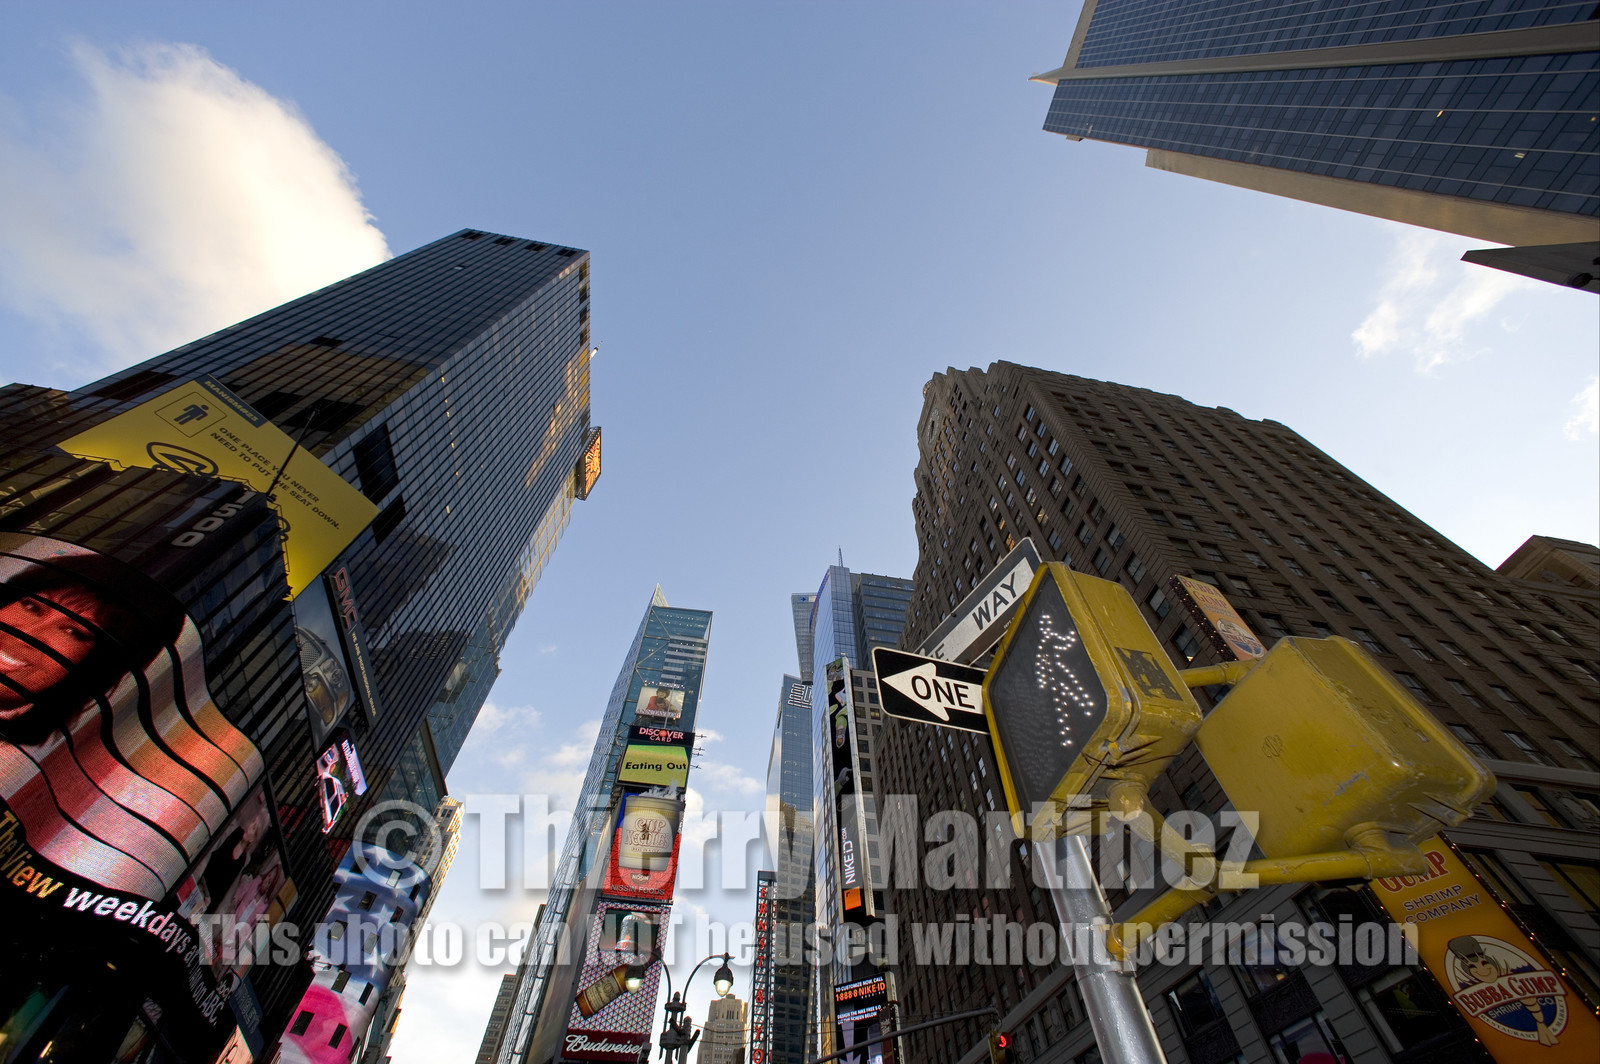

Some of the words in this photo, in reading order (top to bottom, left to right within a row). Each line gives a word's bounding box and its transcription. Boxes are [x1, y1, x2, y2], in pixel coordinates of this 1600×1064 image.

[210, 432, 238, 452] NEED
[239, 452, 251, 463] TO
[252, 463, 272, 477] PUT
[275, 478, 289, 491] HE
[289, 490, 312, 507] SEAT
[312, 507, 340, 530] DOWN.
[219, 427, 241, 443] ONE
[241, 443, 271, 466] PLACE
[291, 480, 320, 503] NEVER
[335, 567, 358, 629] GMC
[972, 572, 1019, 631] WAY
[911, 674, 976, 709] ONE
[639, 727, 684, 740] DISCOVER
[625, 762, 662, 771] Eating
[667, 762, 687, 770] Out
[625, 830, 669, 848] NOODLES
[635, 817, 666, 833] CUP
[610, 884, 636, 892] NISSIN
[638, 886, 665, 895] FOODS
[1402, 884, 1463, 911] SHRIMP
[1405, 893, 1482, 925] COMPANY
[757, 887, 768, 969] ERNST
[62, 887, 192, 953] weekdays
[192, 981, 207, 1005] on
[755, 989, 765, 1003] &
[1459, 983, 1513, 1013] BUBBA
[1508, 976, 1557, 996] GUMP
[1488, 1001, 1522, 1018] SHRIMP
[1480, 1014, 1536, 1039] RESTAURANT
[1556, 998, 1565, 1026] MARKET
